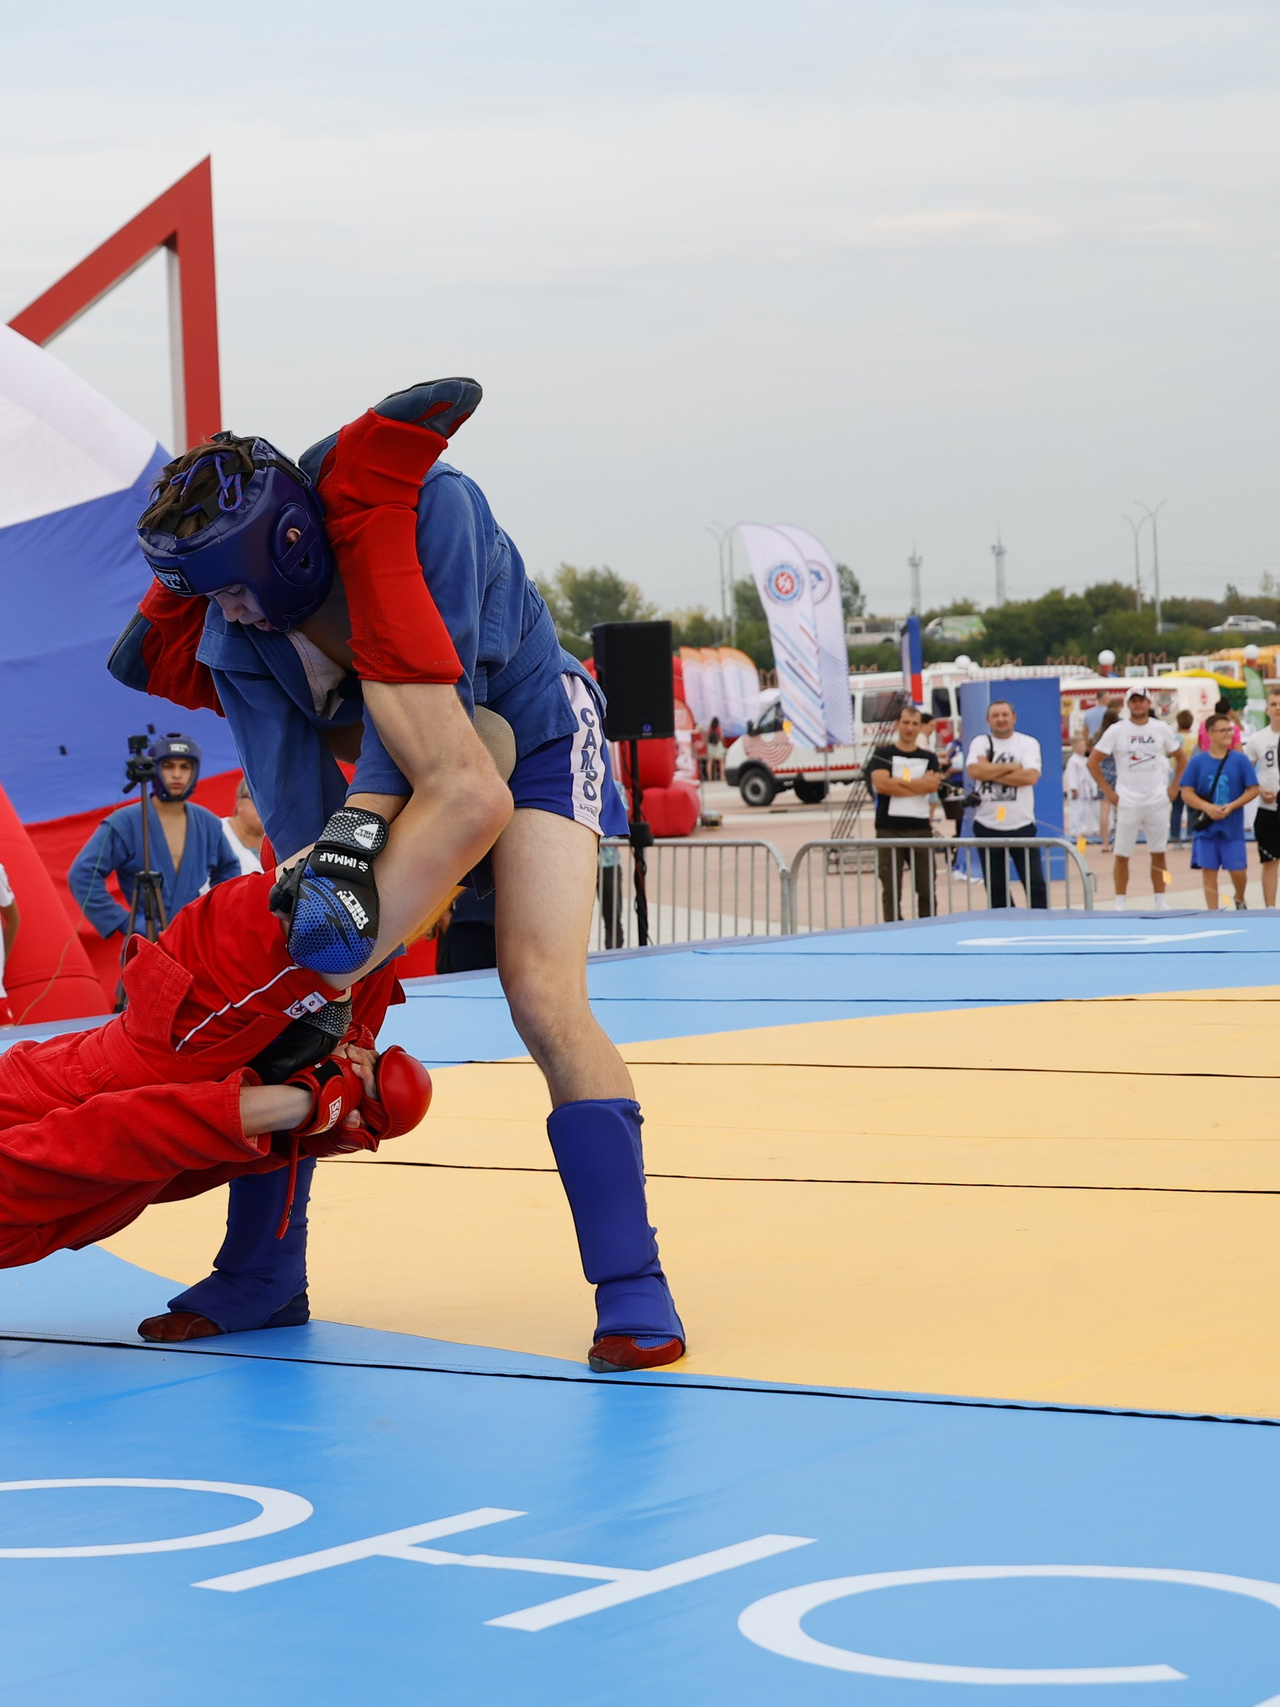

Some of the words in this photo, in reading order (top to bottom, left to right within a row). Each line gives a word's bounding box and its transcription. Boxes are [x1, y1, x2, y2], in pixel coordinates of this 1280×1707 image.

[1130, 735, 1155, 744] FILA
[319, 852, 357, 868] IMMAF
[336, 890, 364, 931] GREEN
[346, 890, 370, 926] HILL
